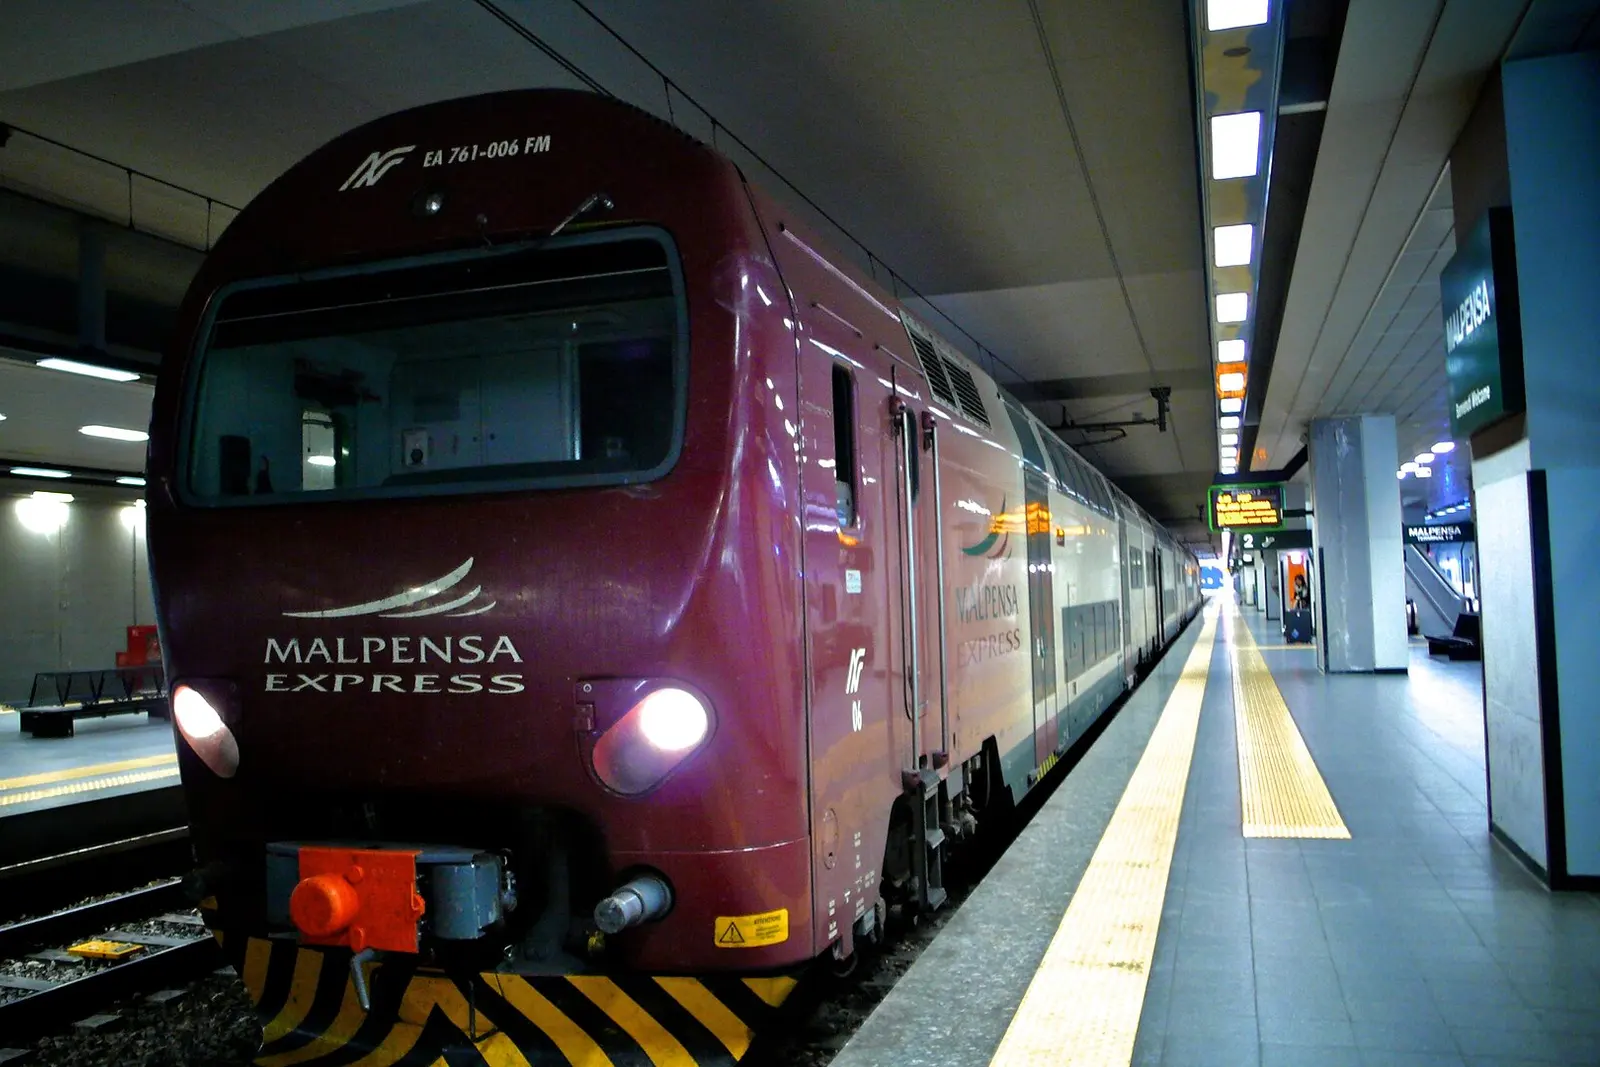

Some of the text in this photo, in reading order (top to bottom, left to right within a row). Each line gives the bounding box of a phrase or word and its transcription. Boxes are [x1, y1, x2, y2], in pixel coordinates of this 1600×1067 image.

[423, 135, 551, 168] EA 761-006 FM
[1446, 279, 1490, 353] MALPENSA
[1243, 534, 1254, 549] 2
[1408, 526, 1462, 537] MALPENSA
[956, 584, 1019, 624] MALPENSA
[264, 635, 524, 664] MALPENSA
[956, 627, 1021, 669] EXPRESS
[264, 673, 526, 694] EXPRESS
[852, 700, 863, 733] 06
